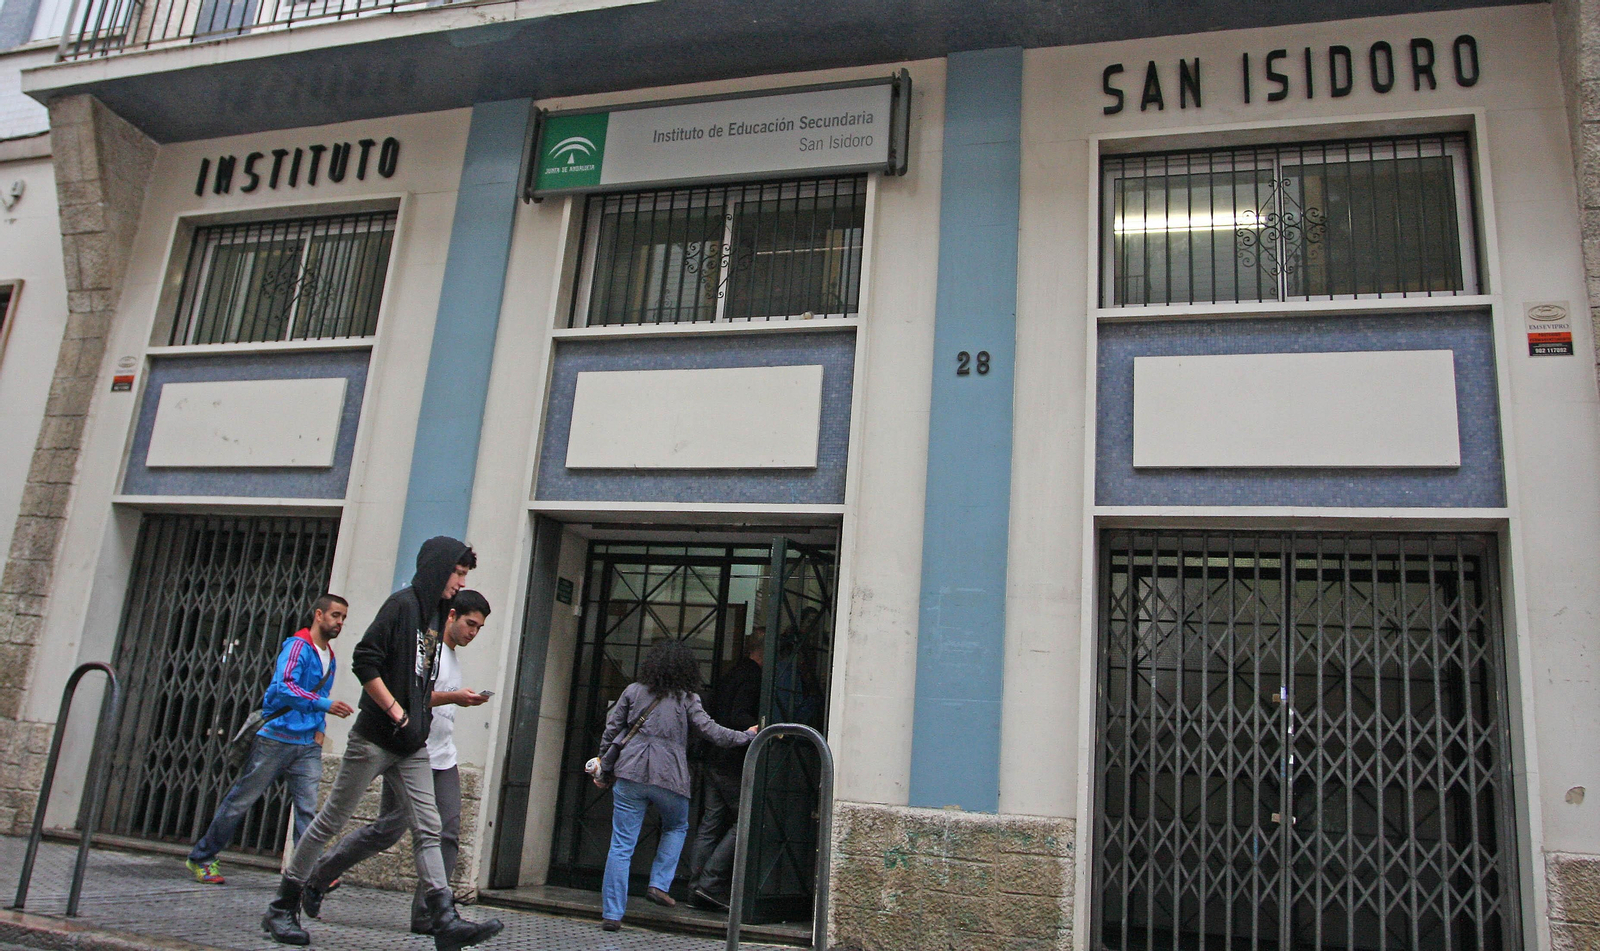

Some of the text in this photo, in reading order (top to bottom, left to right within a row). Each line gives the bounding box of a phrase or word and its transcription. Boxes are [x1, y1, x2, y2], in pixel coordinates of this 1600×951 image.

[1102, 33, 1480, 116] SAN ISIDORO
[652, 110, 874, 144] Instituto de Educación Secundaria
[799, 134, 874, 152] San Isidoro
[194, 136, 400, 197] INSTITUTO
[956, 350, 990, 375] 28
